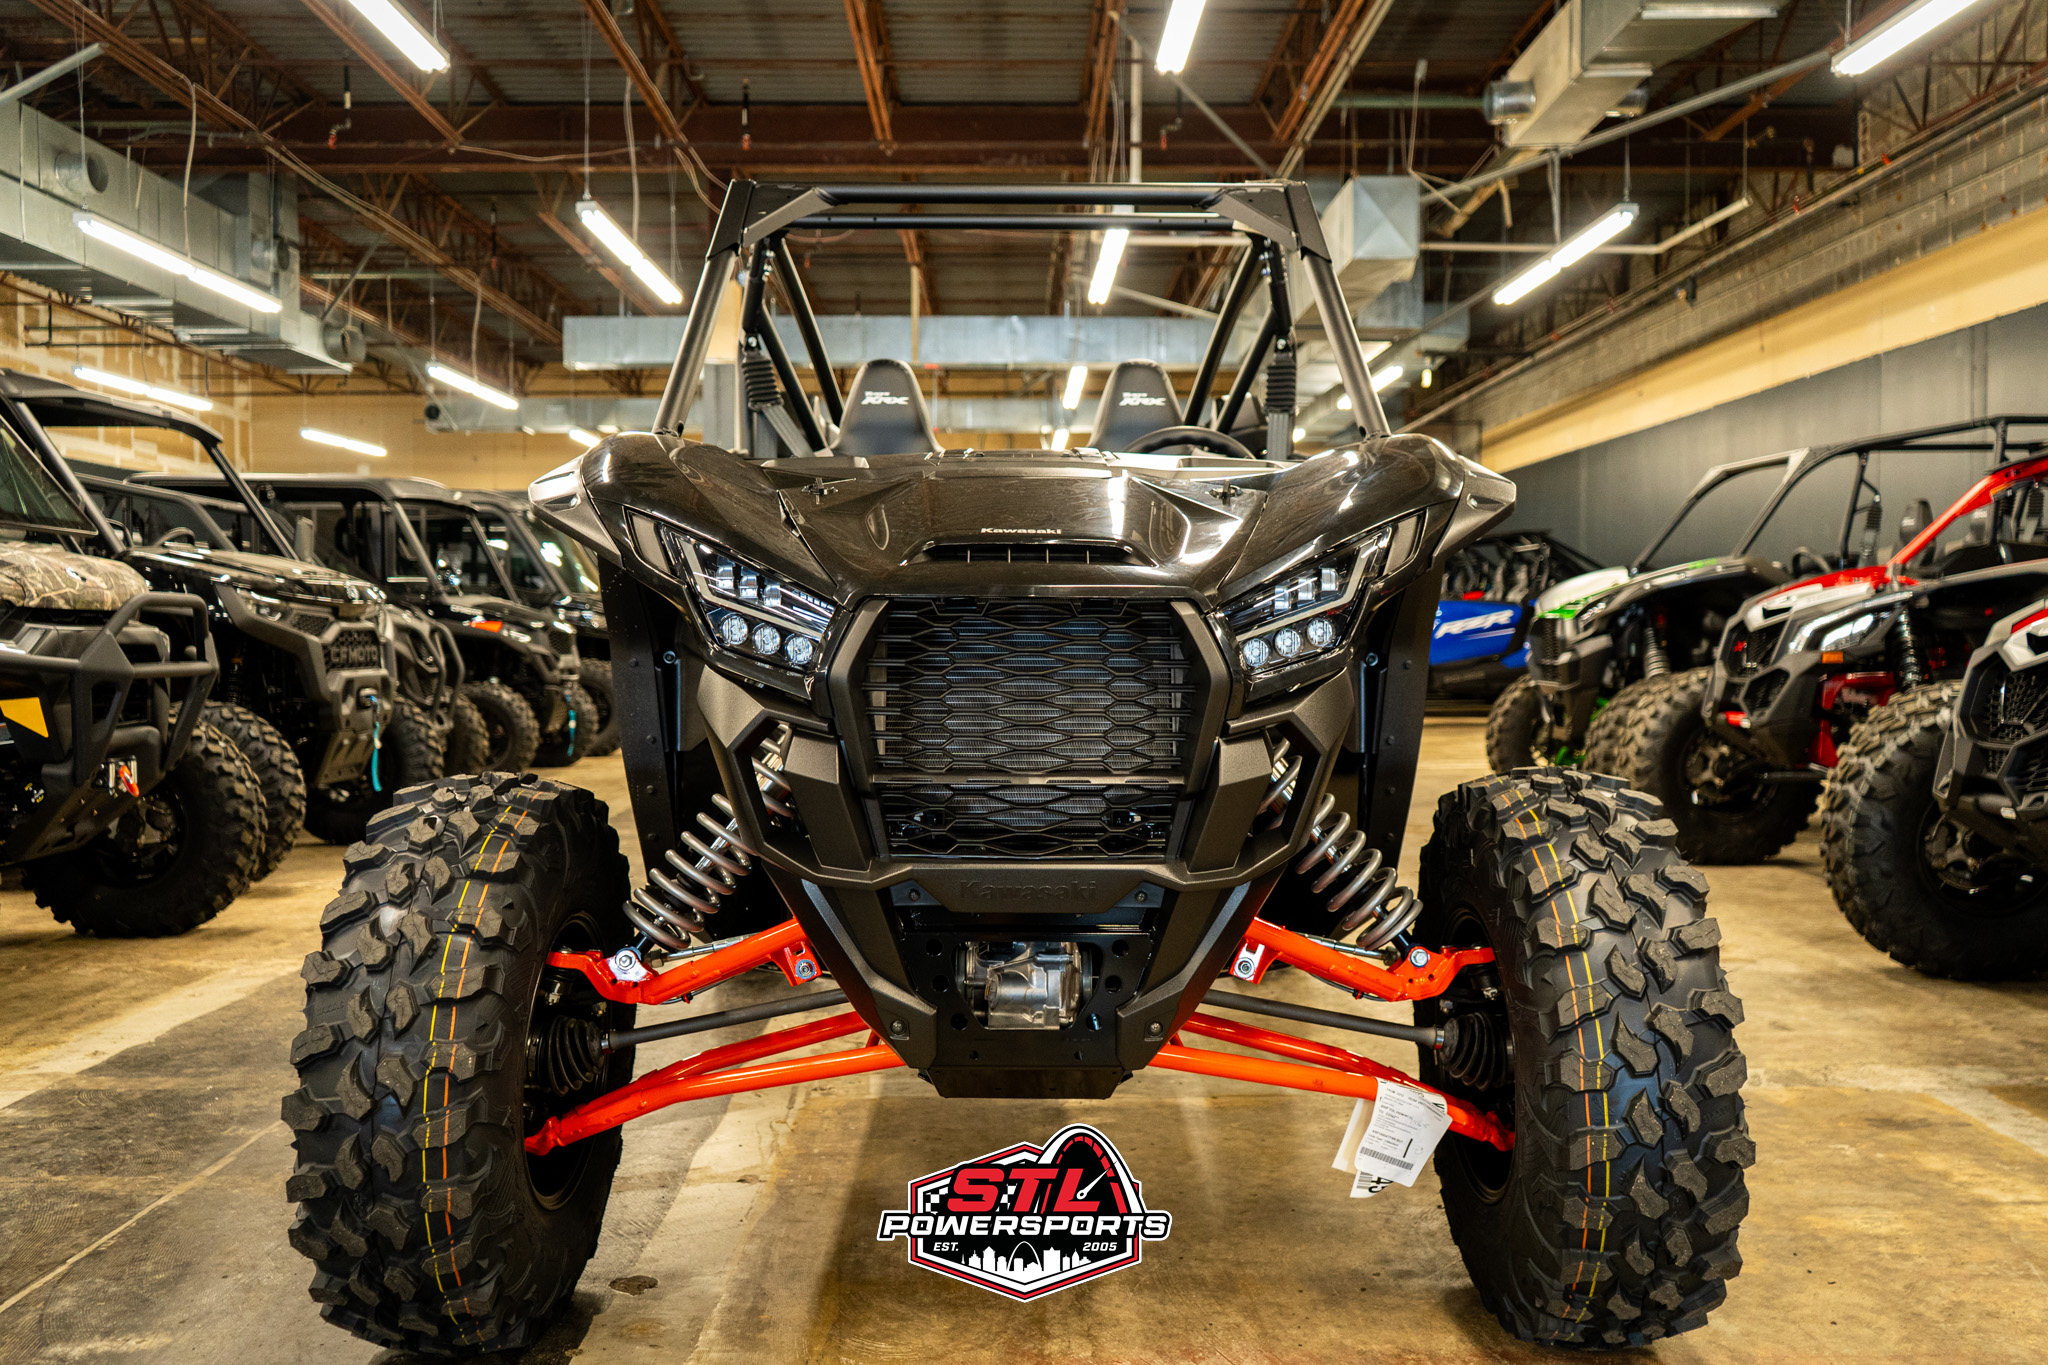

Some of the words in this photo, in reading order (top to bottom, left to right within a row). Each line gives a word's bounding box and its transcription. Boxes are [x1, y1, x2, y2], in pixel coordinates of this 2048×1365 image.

[980, 527, 1063, 535] Kawasaki
[330, 645, 378, 664] CFMOTO
[959, 879, 1098, 900] Kawasaki
